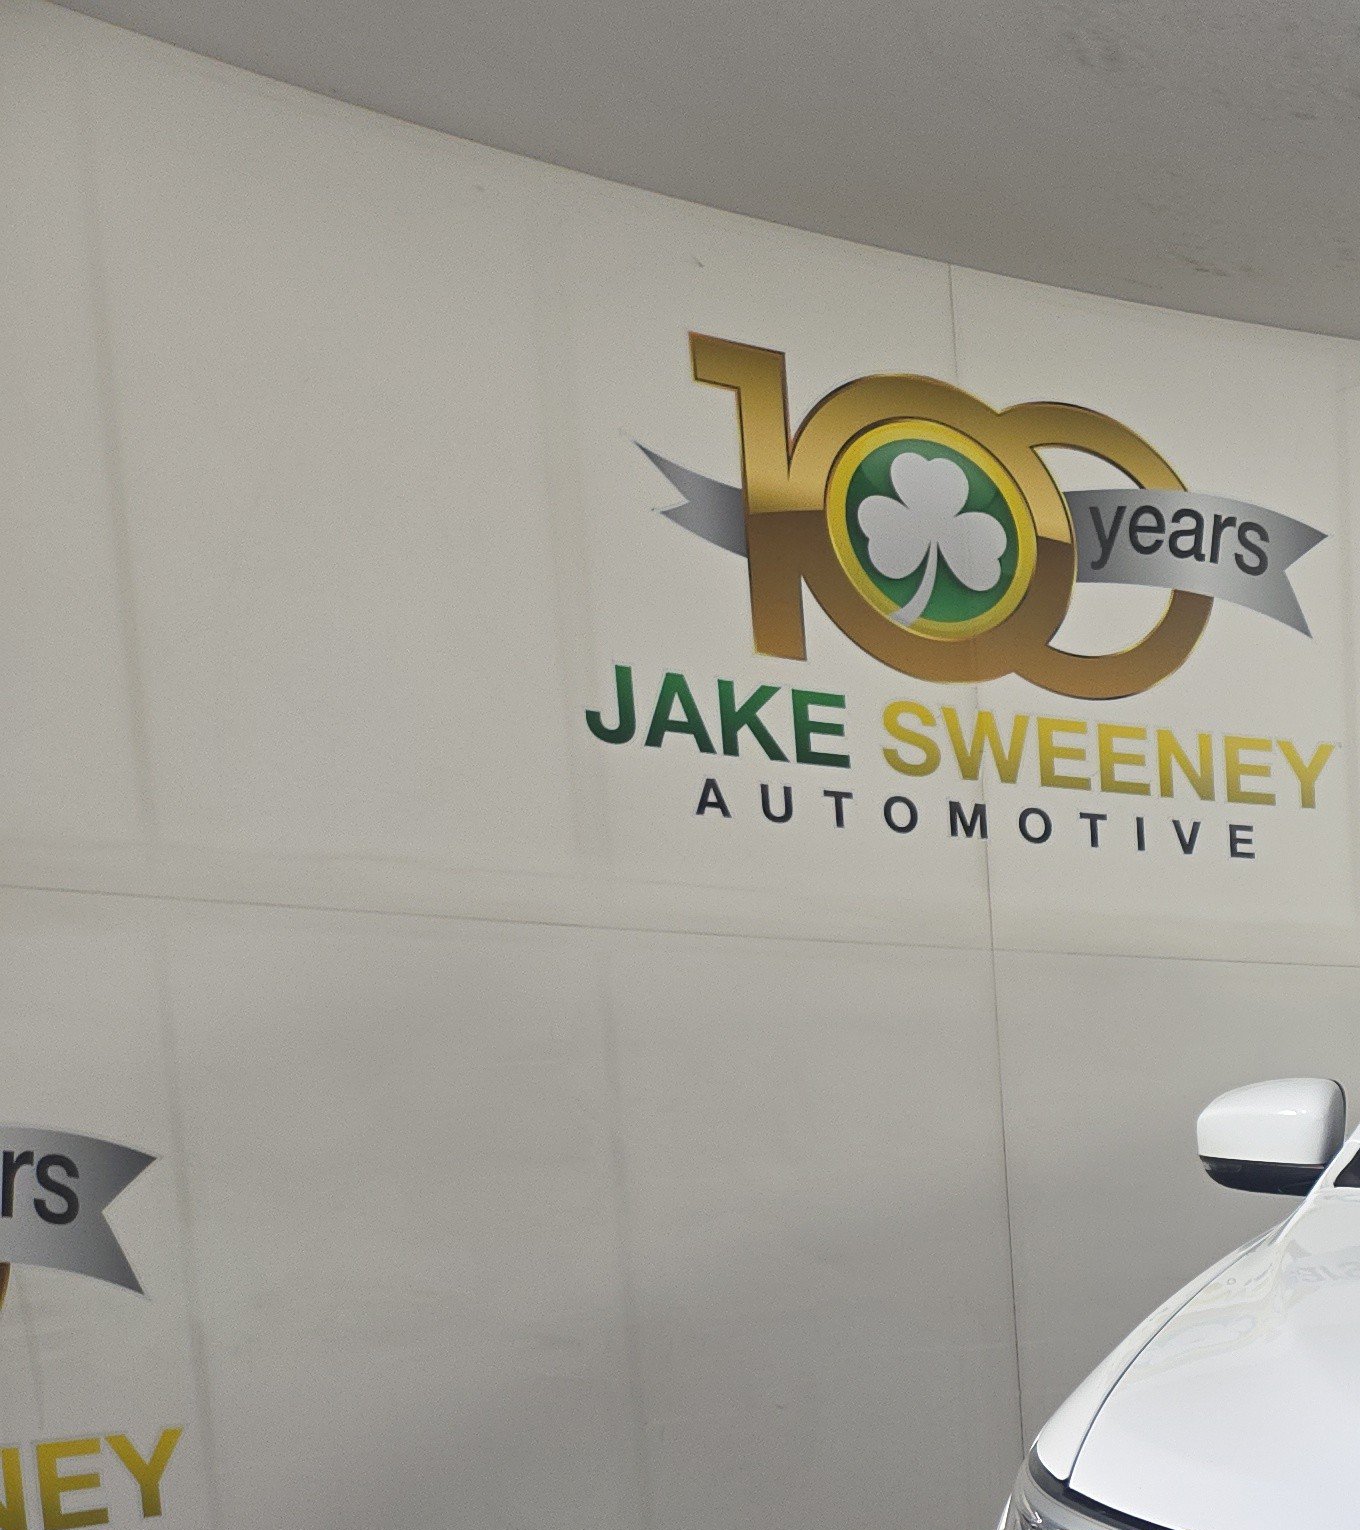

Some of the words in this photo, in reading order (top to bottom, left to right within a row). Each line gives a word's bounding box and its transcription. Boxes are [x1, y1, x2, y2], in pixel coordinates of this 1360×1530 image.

[1088, 503, 1271, 578] years
[585, 664, 851, 769] JAKE
[881, 700, 1335, 810] SWEENEY
[694, 777, 1257, 860] AUTOMOTIVE
